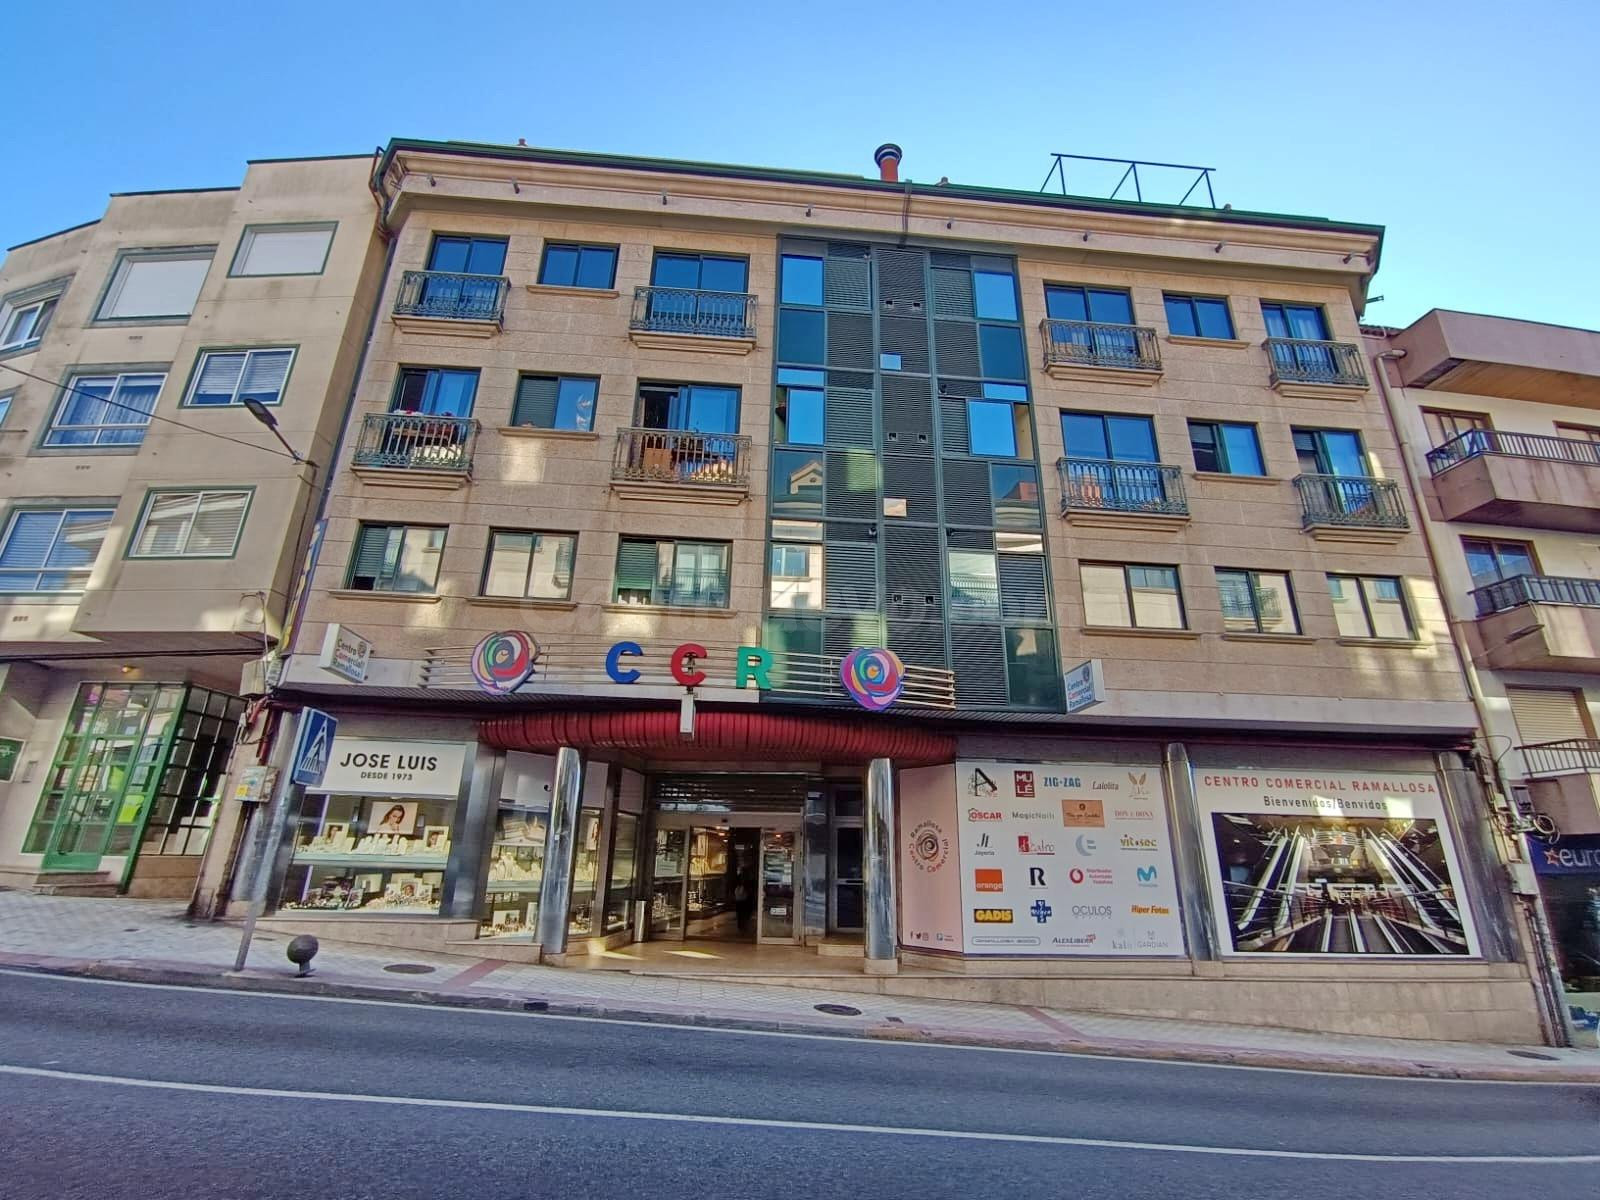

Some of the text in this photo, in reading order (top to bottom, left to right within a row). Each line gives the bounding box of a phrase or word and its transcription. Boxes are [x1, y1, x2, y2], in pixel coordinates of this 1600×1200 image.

[337, 638, 358, 656] Centro
[340, 752, 438, 772] JOSE LUIS
[360, 771, 413, 781] DESDE 1973
[1204, 775, 1436, 793] CENTRO COMERCIAL RAMALLOSA
[970, 810, 1002, 820] OSCAR
[1029, 867, 1046, 886] R
[976, 882, 1004, 892] orange
[975, 909, 1012, 922] GADIS
[1131, 904, 1170, 915] Hiper Fotos
